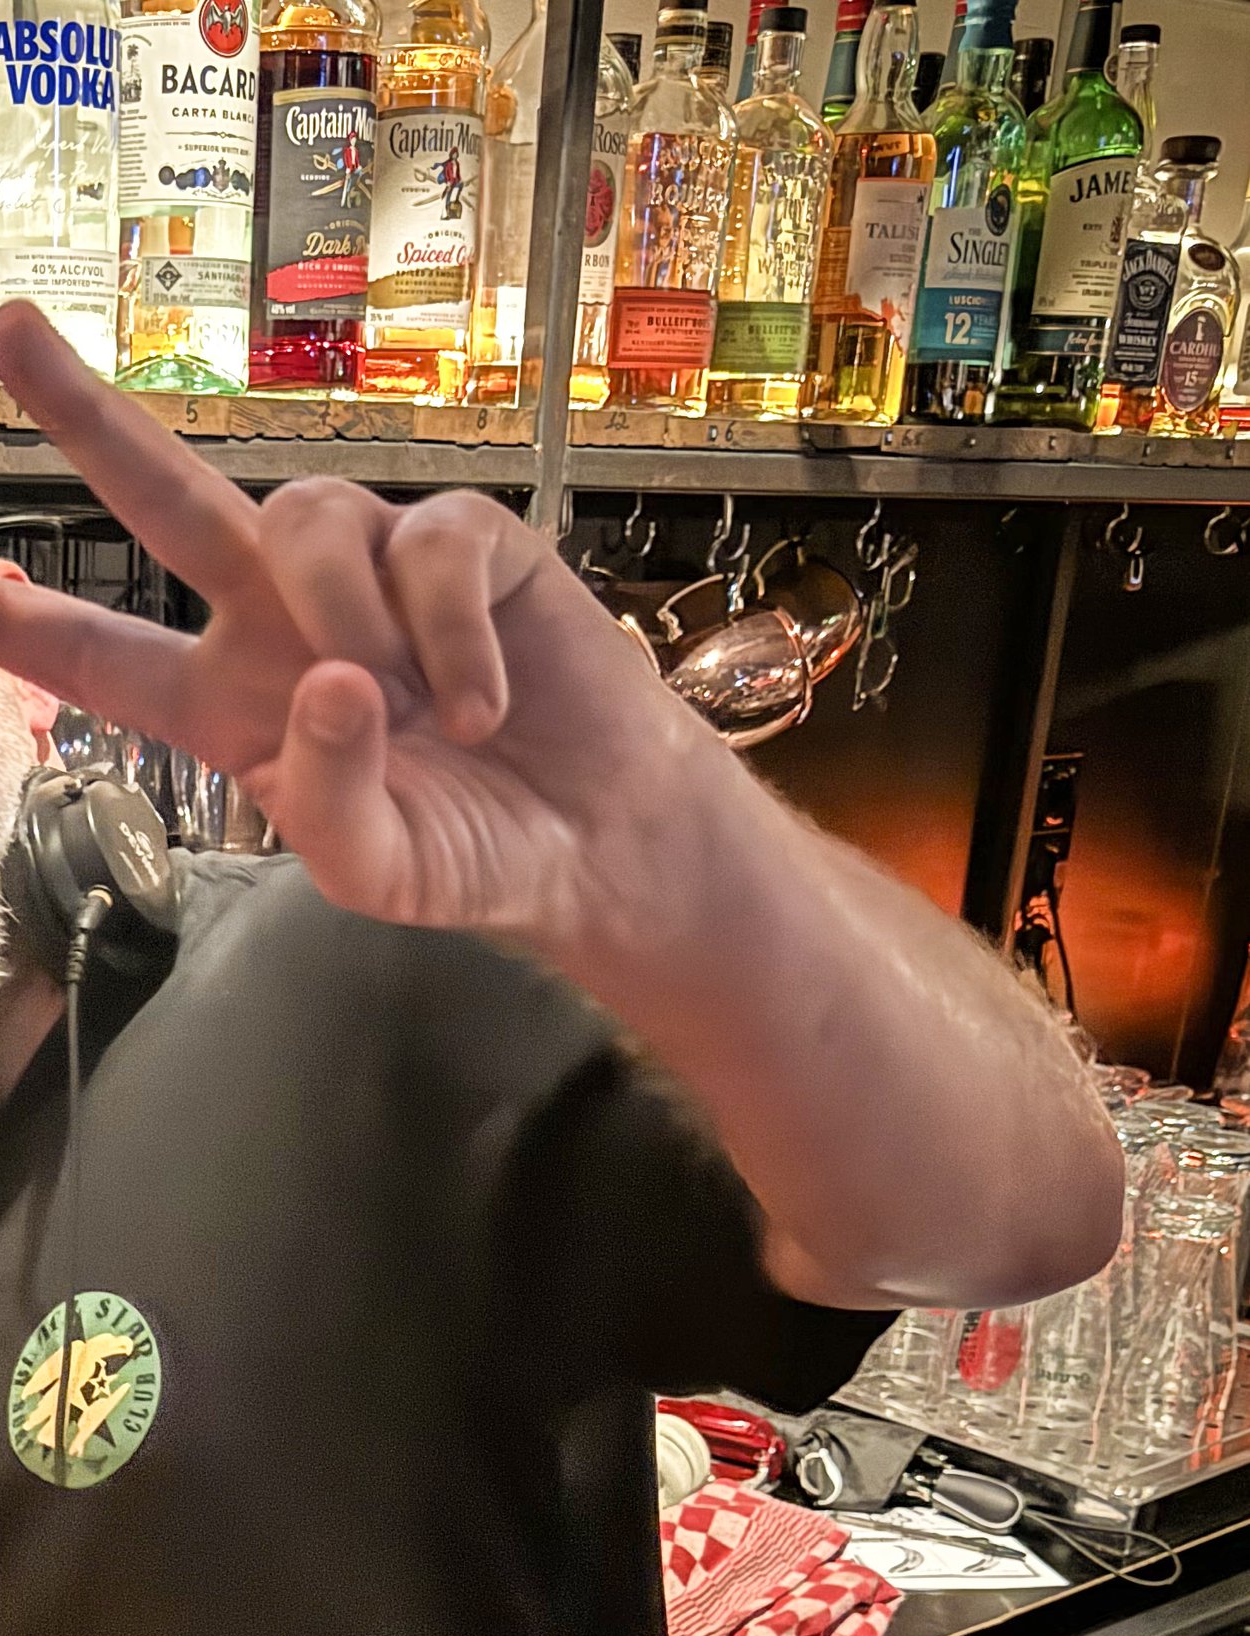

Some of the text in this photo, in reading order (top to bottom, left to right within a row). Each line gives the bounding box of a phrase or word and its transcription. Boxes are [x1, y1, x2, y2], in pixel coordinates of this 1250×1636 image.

[6, 64, 116, 112] VODKA
[172, 107, 216, 118] CARTA
[286, 104, 351, 146] Captain
[184, 143, 219, 153] SUPERIOR
[390, 121, 454, 159] Captain
[303, 232, 351, 256] Dark
[397, 242, 452, 266] Spiced
[32, 264, 105, 277] 40% ALC/VOL
[51, 279, 90, 287] IMPORTED
[647, 316, 689, 328] BULLEIT
[944, 312, 972, 345] 12
[1119, 334, 1158, 347] WHISKEY
[1184, 371, 1199, 387] 15
[476, 408, 487, 429] 8
[725, 421, 736, 442] 6
[123, 1372, 156, 1434] CLUB
